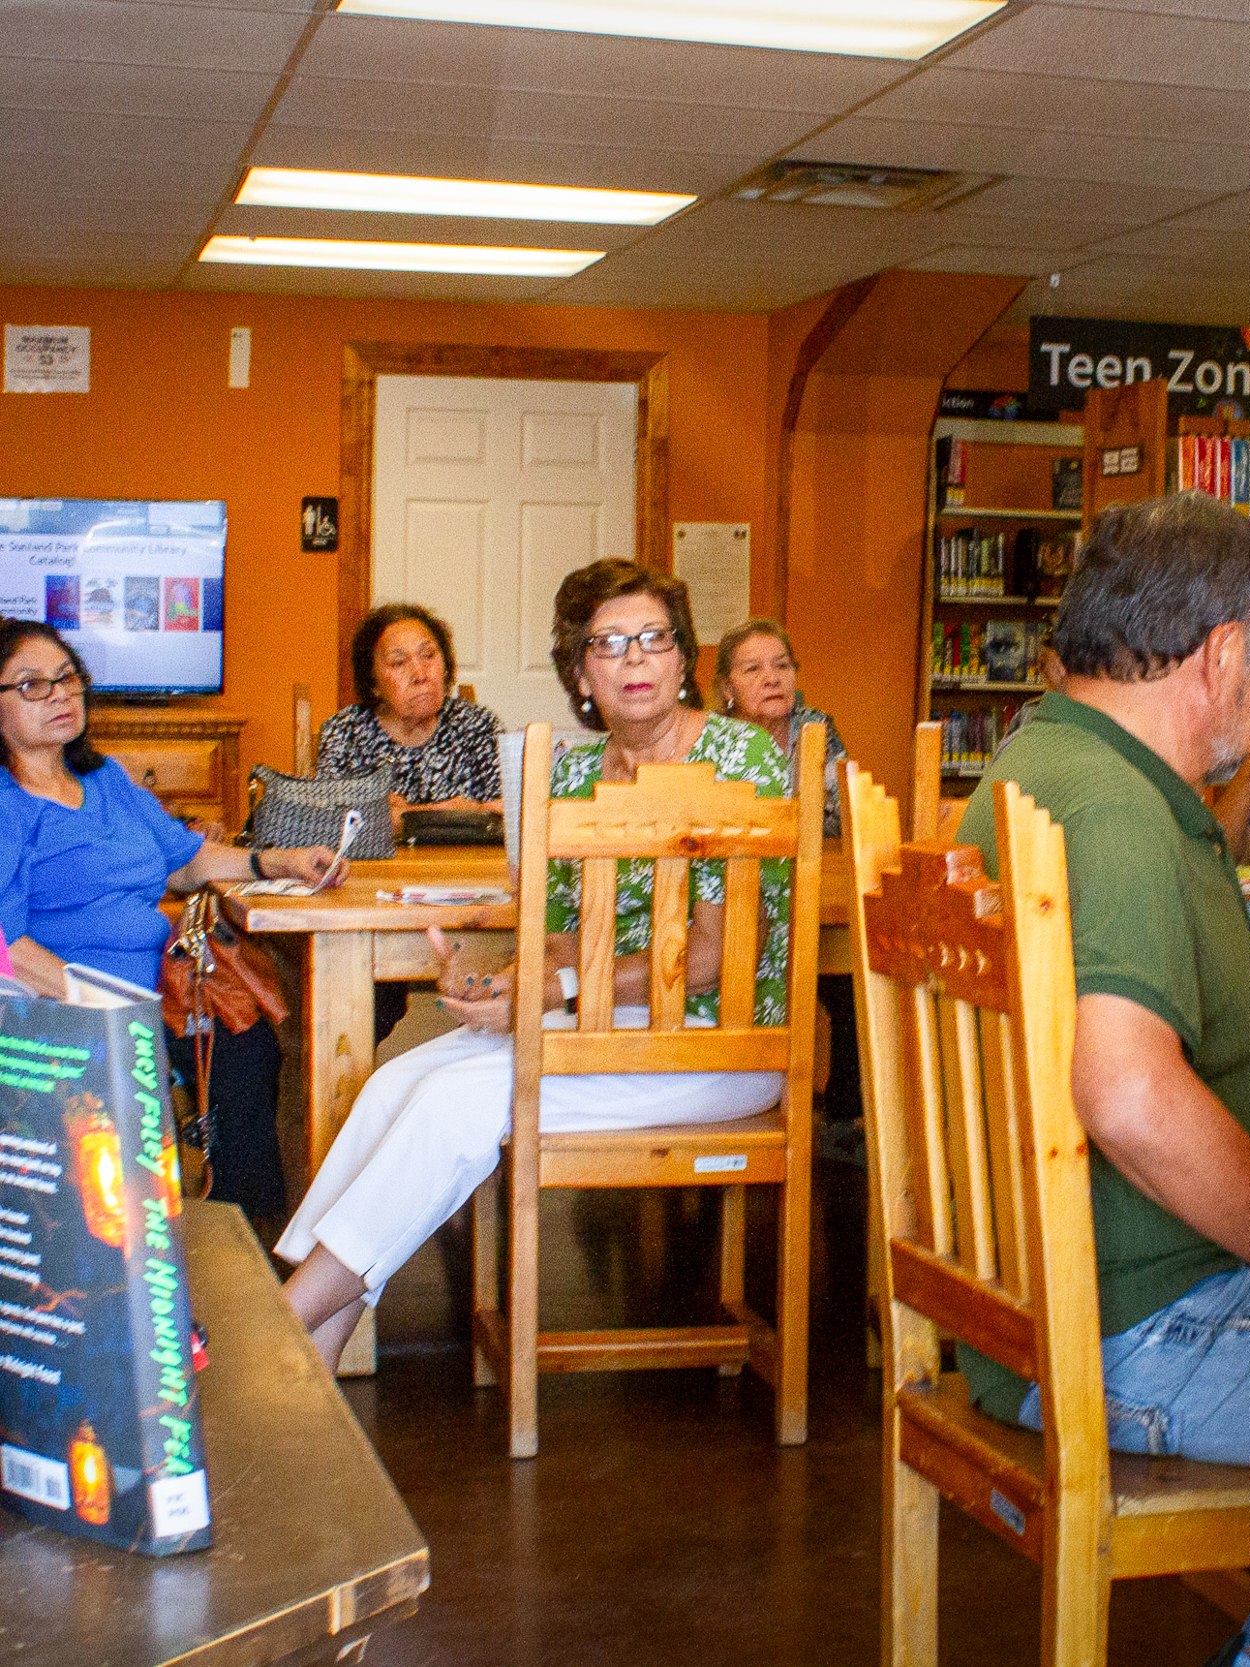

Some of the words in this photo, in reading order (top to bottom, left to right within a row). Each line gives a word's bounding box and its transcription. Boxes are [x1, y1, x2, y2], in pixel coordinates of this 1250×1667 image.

[1040, 342, 1152, 390] Teen
[142, 1198, 171, 1250] THE
[158, 1413, 195, 1479] FEA
